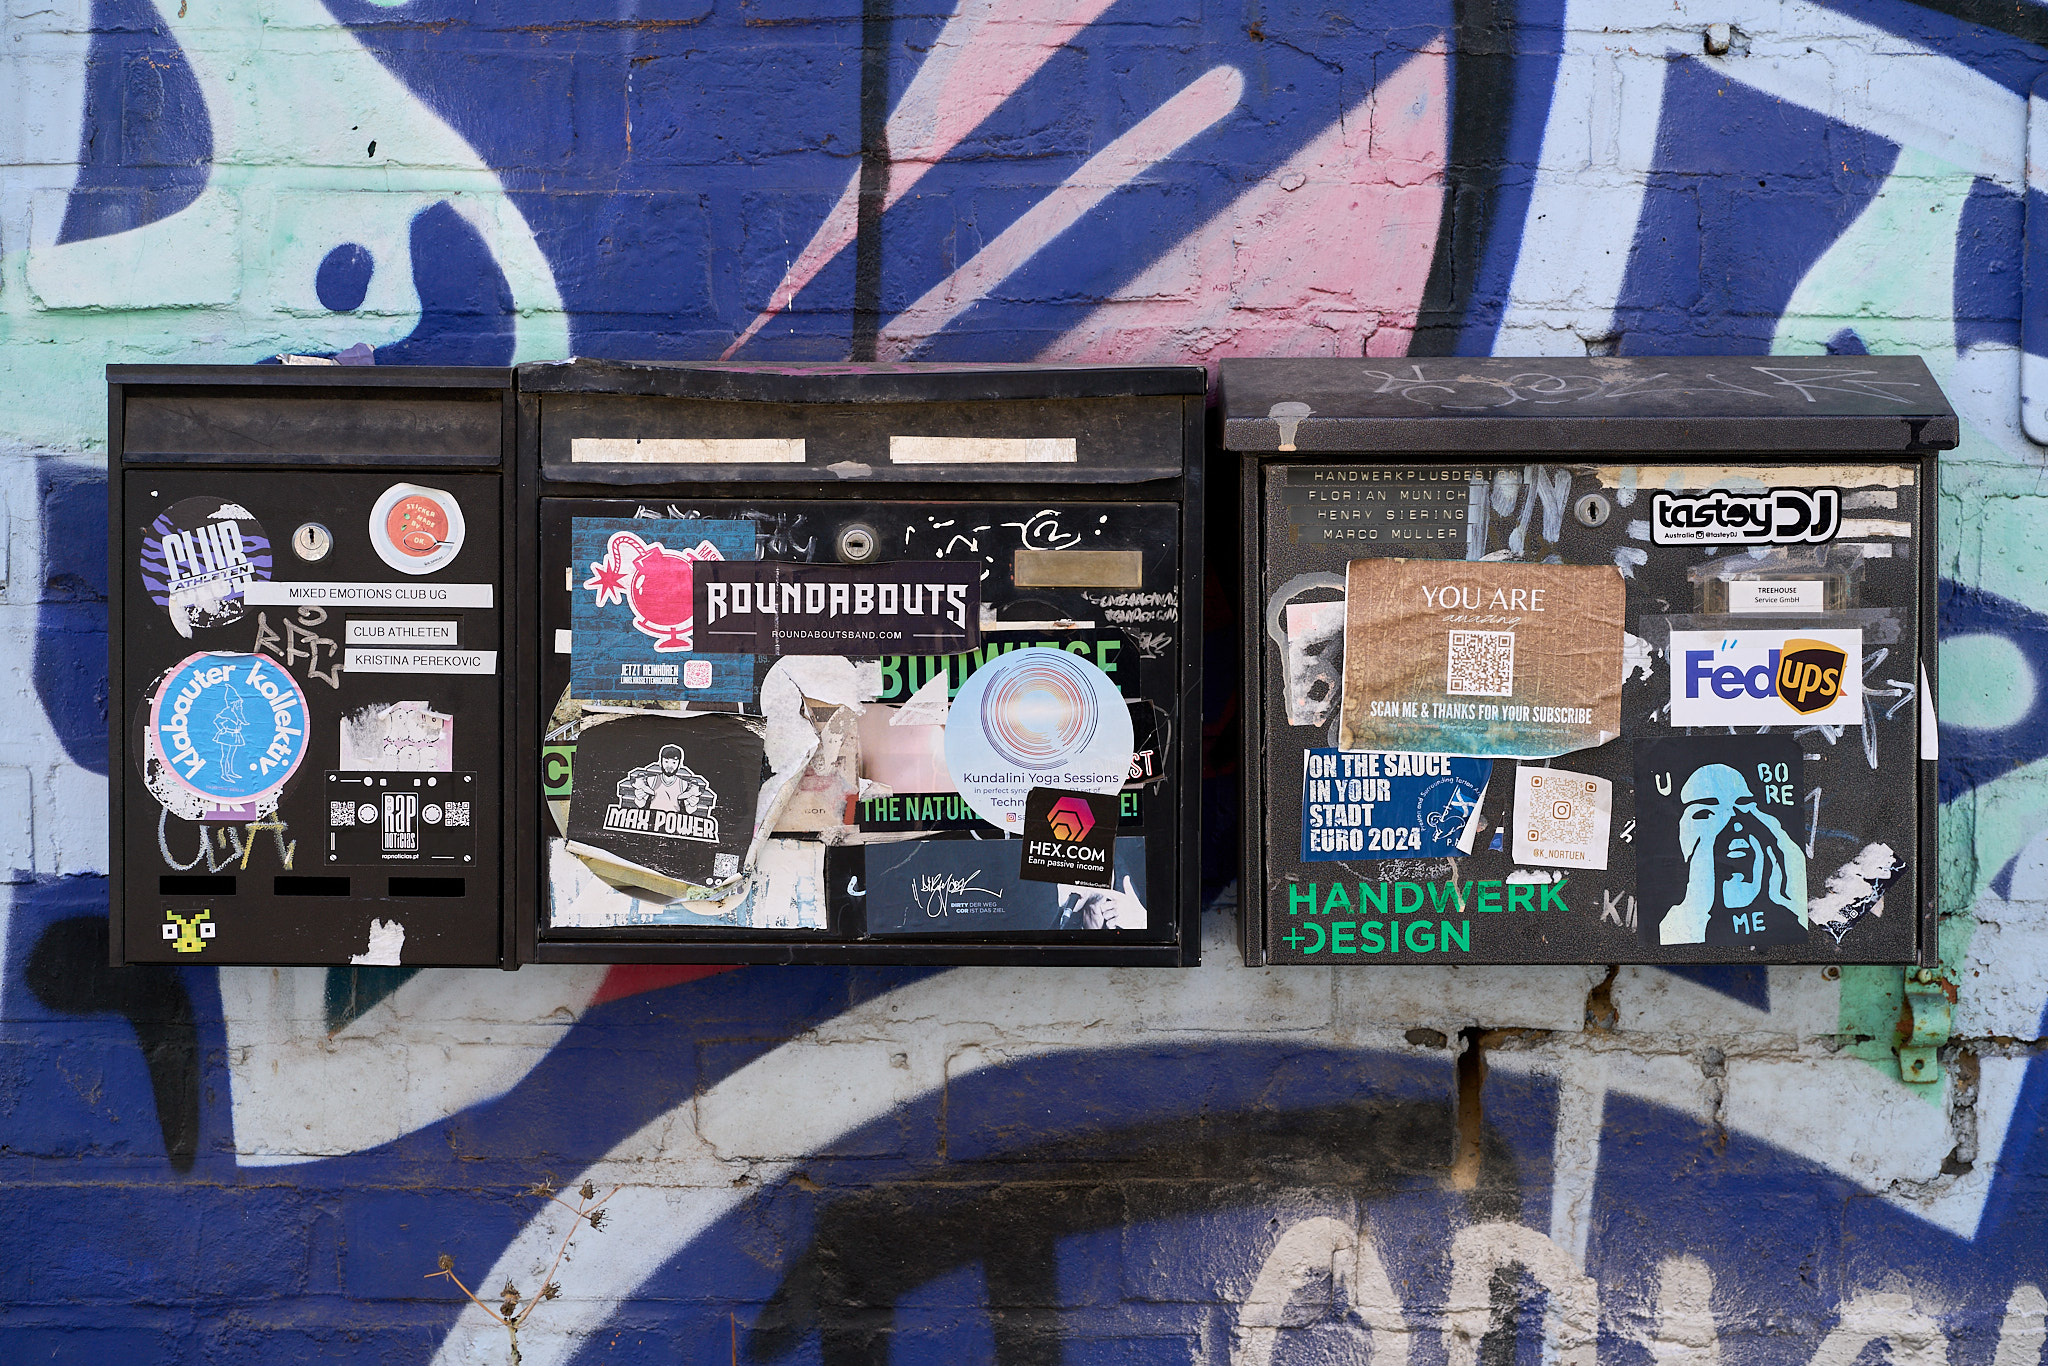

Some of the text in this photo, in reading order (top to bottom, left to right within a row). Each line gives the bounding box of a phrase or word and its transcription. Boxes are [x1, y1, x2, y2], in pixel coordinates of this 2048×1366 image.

[1314, 471, 1518, 481] HANDWERKPLUSDESIGN
[1308, 490, 1387, 500] FLORIAN
[406, 503, 436, 517] STICKER
[1317, 509, 1464, 520] HENRY SIERING
[416, 515, 436, 528] MADE
[1323, 528, 1458, 540] MARCO MÜLLER
[289, 588, 447, 600] MIXED EMOTIONS CLUB UG
[1421, 585, 1546, 612] YOU ARE
[706, 582, 969, 630] ROUNDABOUTS
[353, 626, 449, 638] CLUB ATHLETEN
[1442, 614, 1522, 632] amazing
[771, 629, 902, 640] ROUNDABOUTSBAND.COM
[355, 655, 481, 667] KRISTINA PEREKOVIC
[621, 663, 641, 677] JETZT
[1370, 701, 1593, 724] SCAN ME & THANKS FOR YOUR SUBSCRIBE
[161, 664, 237, 780] klabauter
[1309, 754, 1452, 778] ON THE SAUCE
[963, 772, 1119, 785] Kundalini Yoga Sessions
[1655, 762, 1789, 796] U BO
[983, 787, 1009, 795] perfect
[1309, 778, 1391, 803] IN YOUR
[1765, 784, 1795, 806] RE
[862, 797, 901, 822] THE
[906, 796, 984, 822] NATUR
[990, 797, 1027, 807] Techn
[608, 808, 716, 839] MAX POWER
[1309, 803, 1374, 828] STADT
[1310, 827, 1422, 852] EURO 2024
[1029, 840, 1105, 863] HEX.COM
[1533, 848, 1585, 860] @K_NORTUEN
[1028, 855, 1104, 872] Earn passive income
[1289, 879, 1570, 915] HANDWERK
[1732, 911, 1766, 935] ME
[1282, 920, 1470, 954] +DESIGN
